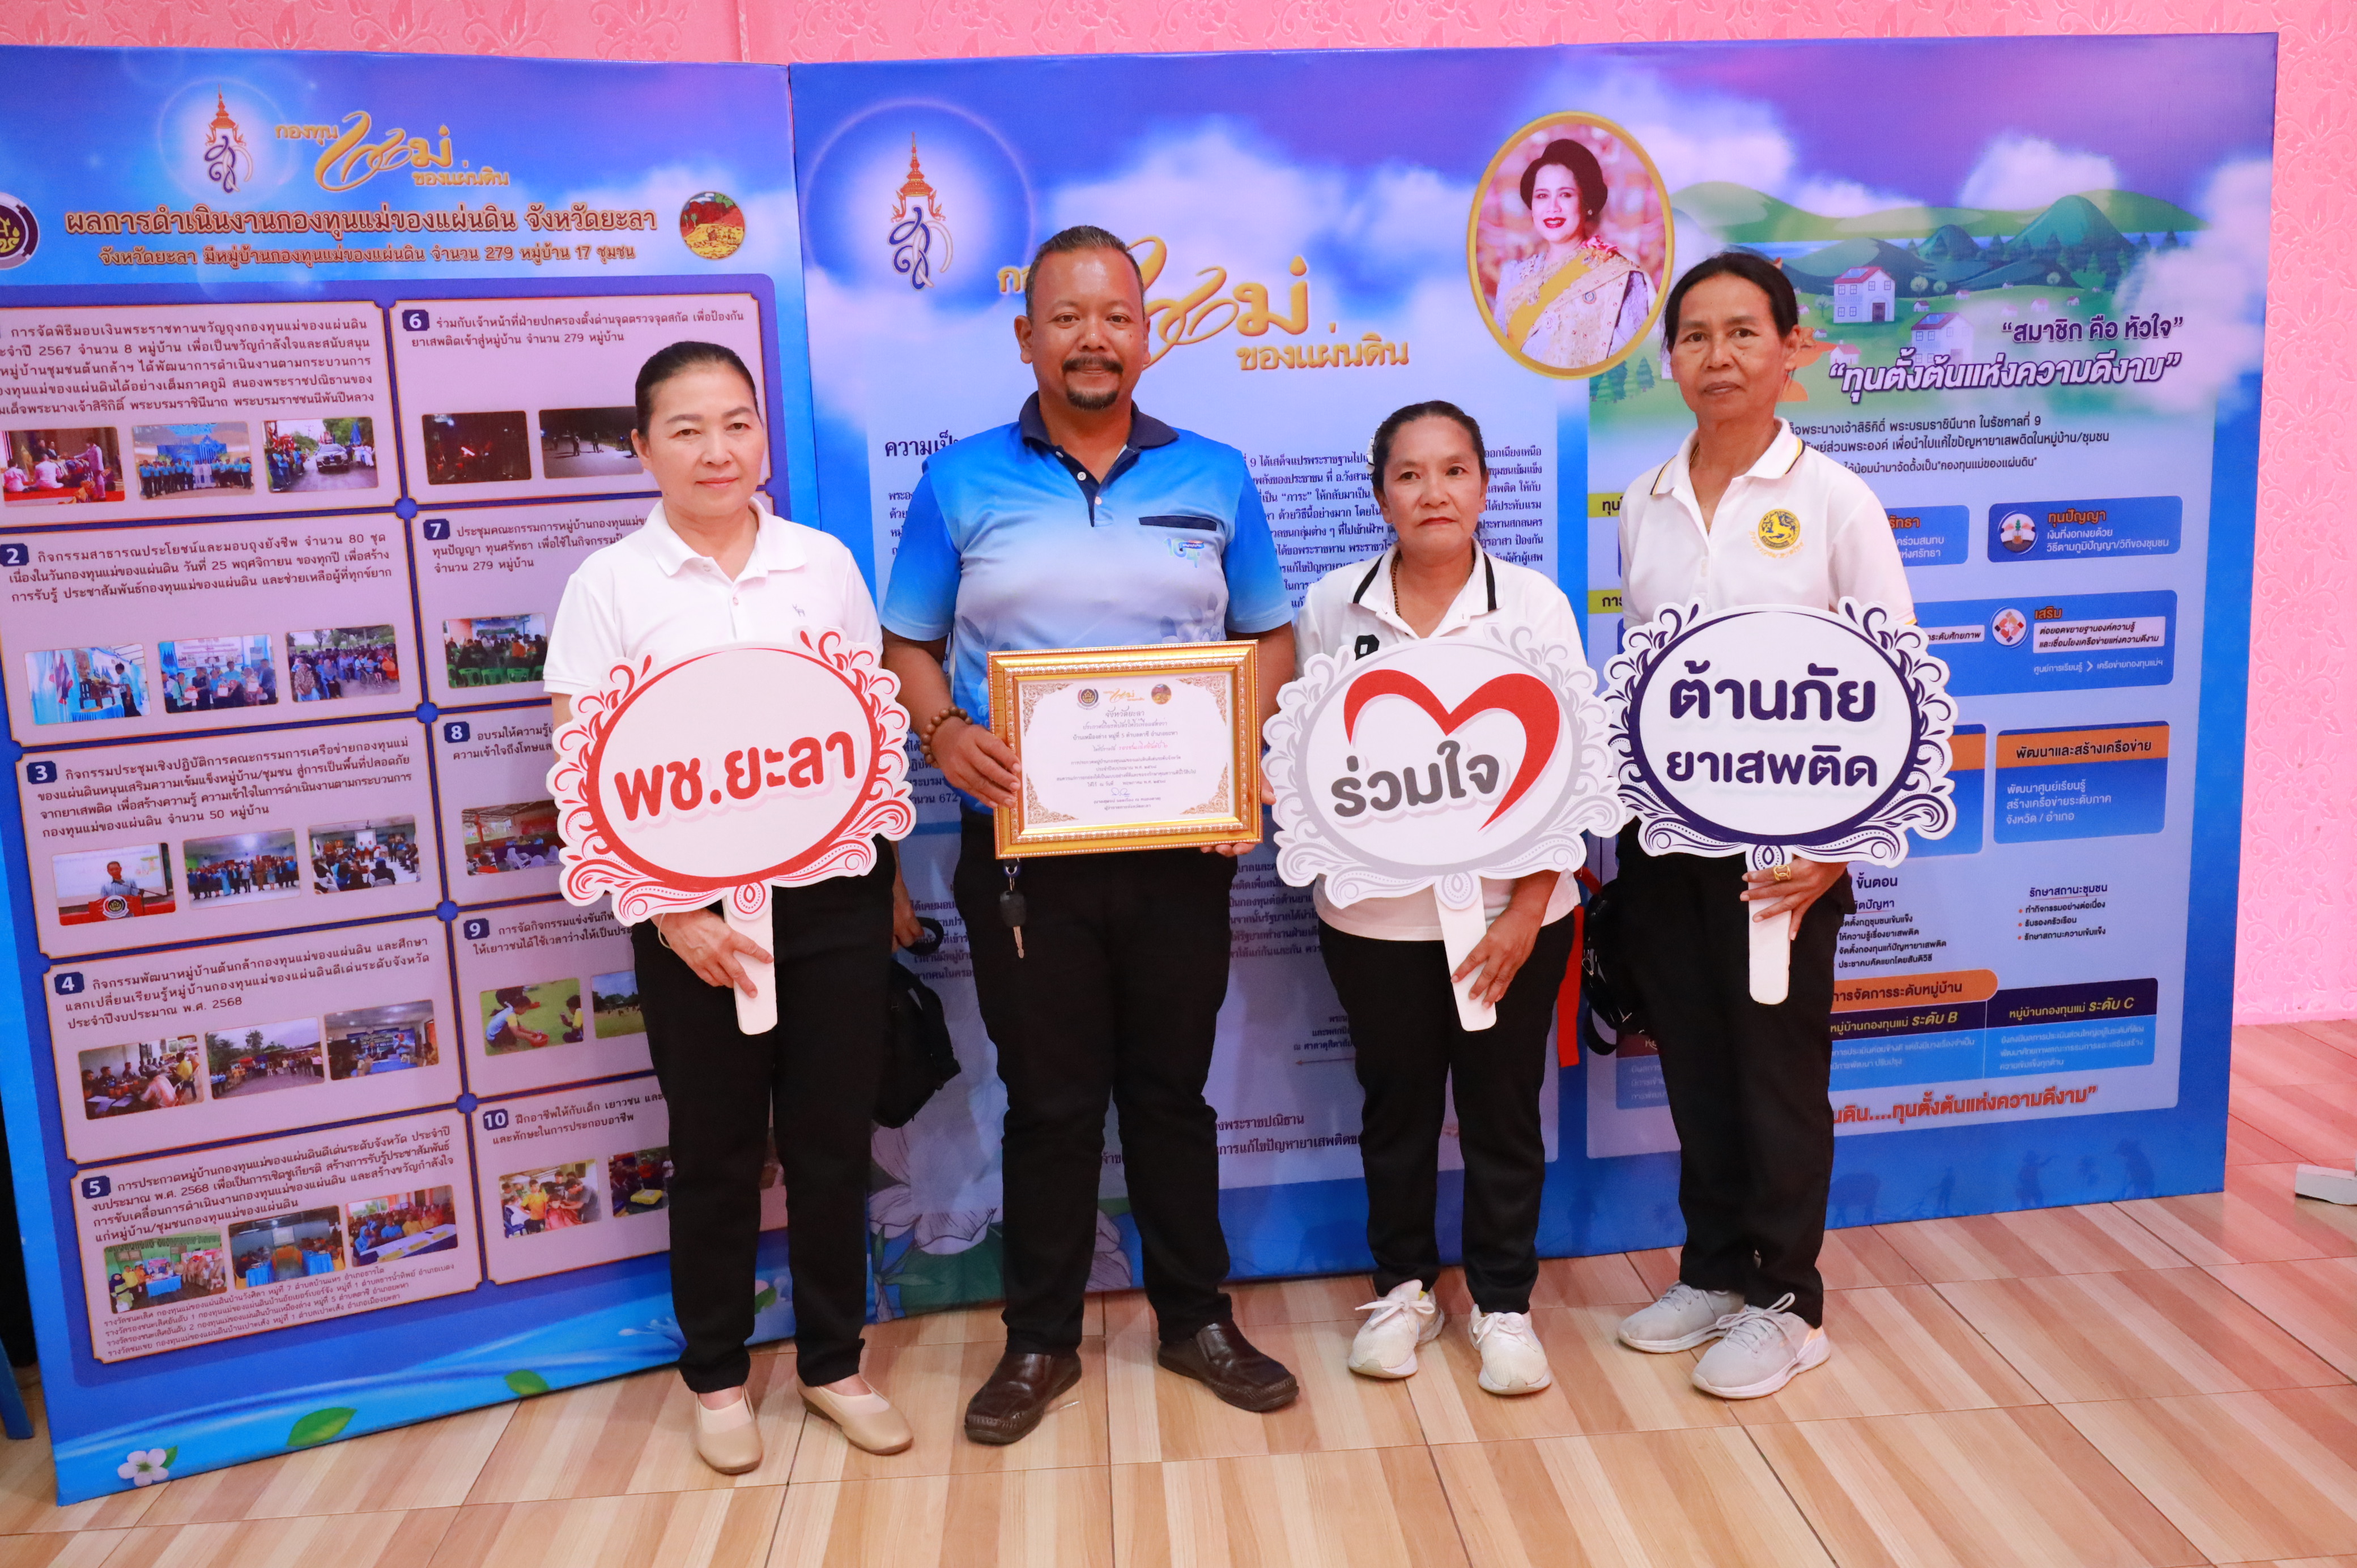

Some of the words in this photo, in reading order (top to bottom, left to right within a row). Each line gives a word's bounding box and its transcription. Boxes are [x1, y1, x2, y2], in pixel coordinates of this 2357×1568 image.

[274, 124, 338, 146] กองทุน
[411, 160, 510, 186] ของแผ่นดิน
[65, 202, 517, 240] ผลการดำเนินงานกองทุนแม่ของแผ่นดิน
[525, 203, 657, 230] จังหวัดยะลา
[99, 245, 197, 265] จังหวัดยะลา
[203, 241, 426, 269] มีหมู่บ้านกองทุนแม่ของแผ่นดิน
[430, 244, 479, 261] จำนวน
[486, 245, 513, 261] 279
[520, 242, 571, 265] หมู่บ้าน
[575, 245, 592, 260] 17
[597, 245, 636, 263] ชุมชน
[409, 313, 423, 329] 6
[694, 309, 743, 321] เพื่อป้องกัน
[2089, 316, 2118, 341] คือ
[39, 346, 70, 356] 2567
[79, 344, 118, 355] จำนวน
[125, 344, 131, 353] 8
[139, 341, 181, 356] หมู่บ้าน
[188, 336, 369, 353] เพื่อเป็นขวัญกำลังใจและสนับสนุน
[412, 333, 521, 348] ยาเสพติดเข้าสู่หมู่บ้าน
[527, 334, 559, 343] จำนวน
[565, 334, 584, 342] 279
[589, 330, 624, 345] หมู่บ้าน
[1236, 322, 1409, 370] ของแผ่นดิน
[138, 358, 370, 372] ได้พัฒนาการดำเนินงานตามกระบวนการ
[233, 374, 372, 387] สนองพระราชปณิธานของ
[130, 397, 227, 410] พระบรมราชินีนาถ
[1980, 414, 2030, 428] ในรัชกาลที่
[2035, 416, 2041, 425] 9
[1520, 480, 1541, 491] ให้กับ
[2047, 508, 2107, 529] ทุนปัญญา
[429, 523, 442, 538] 7
[1516, 534, 1543, 544] ป้องกัน
[305, 536, 342, 546] จำนวน
[350, 534, 364, 543] 80
[371, 534, 385, 545] ชุด
[6, 548, 20, 564] 2
[433, 544, 480, 559] ทุนปัญญา
[486, 540, 533, 555] ทุนศรัทธา
[10, 563, 178, 582] เนื่องในวันกองทุนแม่ของแผ่นดิน
[184, 557, 206, 571] วันที่
[212, 561, 227, 570] 25
[232, 557, 292, 570] พฤศจิกายน
[297, 552, 339, 566] ของทุกปี
[345, 548, 389, 561] เพื่อสร้าง
[435, 563, 468, 573] จำนวน
[474, 561, 493, 570] 279
[499, 557, 534, 572] หมู่บ้าน
[12, 587, 57, 603] การรับรู้
[262, 566, 392, 585] และช่วยเหลือผู้ที่ทุกข์ยาก
[2034, 606, 2062, 620] เสริม
[1669, 659, 1876, 722] ต้านภัย
[450, 725, 463, 740] 8
[2016, 739, 2151, 758] พัฒนาและสร้างเครือข่าย
[35, 765, 48, 781] 3
[297, 755, 409, 778] สู่การเป็นพื้นที่ปลอดภัย
[1666, 744, 1878, 787] ยาเสพติด
[613, 730, 856, 821] พช.ยะลา
[1330, 739, 1500, 818] ร่วมใจ
[41, 803, 112, 819] จากยาเสพติด
[118, 792, 197, 811] เพื่อสร้างความรู้
[43, 816, 161, 838] กองทุนแม่ของแผ่นดิน
[168, 813, 204, 824] จำนวน
[210, 810, 224, 819] 50
[231, 804, 269, 819] หมู่บ้าน
[2007, 814, 2036, 824] จังหวัด
[2047, 811, 2074, 821] อำเภอ
[1856, 872, 1898, 889] ขั้นตอน
[2030, 885, 2107, 897] รักษาสถานะชุมชน
[469, 922, 482, 938] 9
[377, 938, 427, 951] และศึกษา
[61, 976, 76, 992] 4
[68, 1008, 177, 1029] ประจำปีงบประมาณ
[183, 1003, 207, 1012] พ.ศ.
[213, 997, 242, 1008] 2568
[2010, 1005, 2084, 1020] หมู่บ้านกองทุนแม่
[2089, 998, 2120, 1011] ระดับ
[2124, 998, 2134, 1008] C
[1912, 1012, 1944, 1025] ระดับ
[1948, 1012, 1958, 1022] B
[484, 1111, 507, 1127] 10
[516, 1102, 599, 1124] ฝึกอาชีพให้กับเด็ก
[605, 1097, 640, 1109] เยาวชน
[412, 1126, 450, 1141] ประจำปี
[493, 1113, 633, 1144] และทักษะในการประกอบอาชีพ
[89, 1194, 150, 1211] งบประมาณ
[155, 1191, 177, 1200] พ.ศ.
[181, 1179, 209, 1196] 2568
[214, 1163, 321, 1190] เพื่อเป็นการเชิดชูเกียรติ
[326, 1139, 449, 1170] สร้างการรับรู้ประชาสัมพันธ์
[351, 1154, 453, 1181] และสร้างขวัญกำลังใจ
[89, 1180, 102, 1196] 5
[96, 1199, 298, 1242] แก่หมู่บ้าน/ชุมชนกองทุนแม่ของแผ่นดิน
